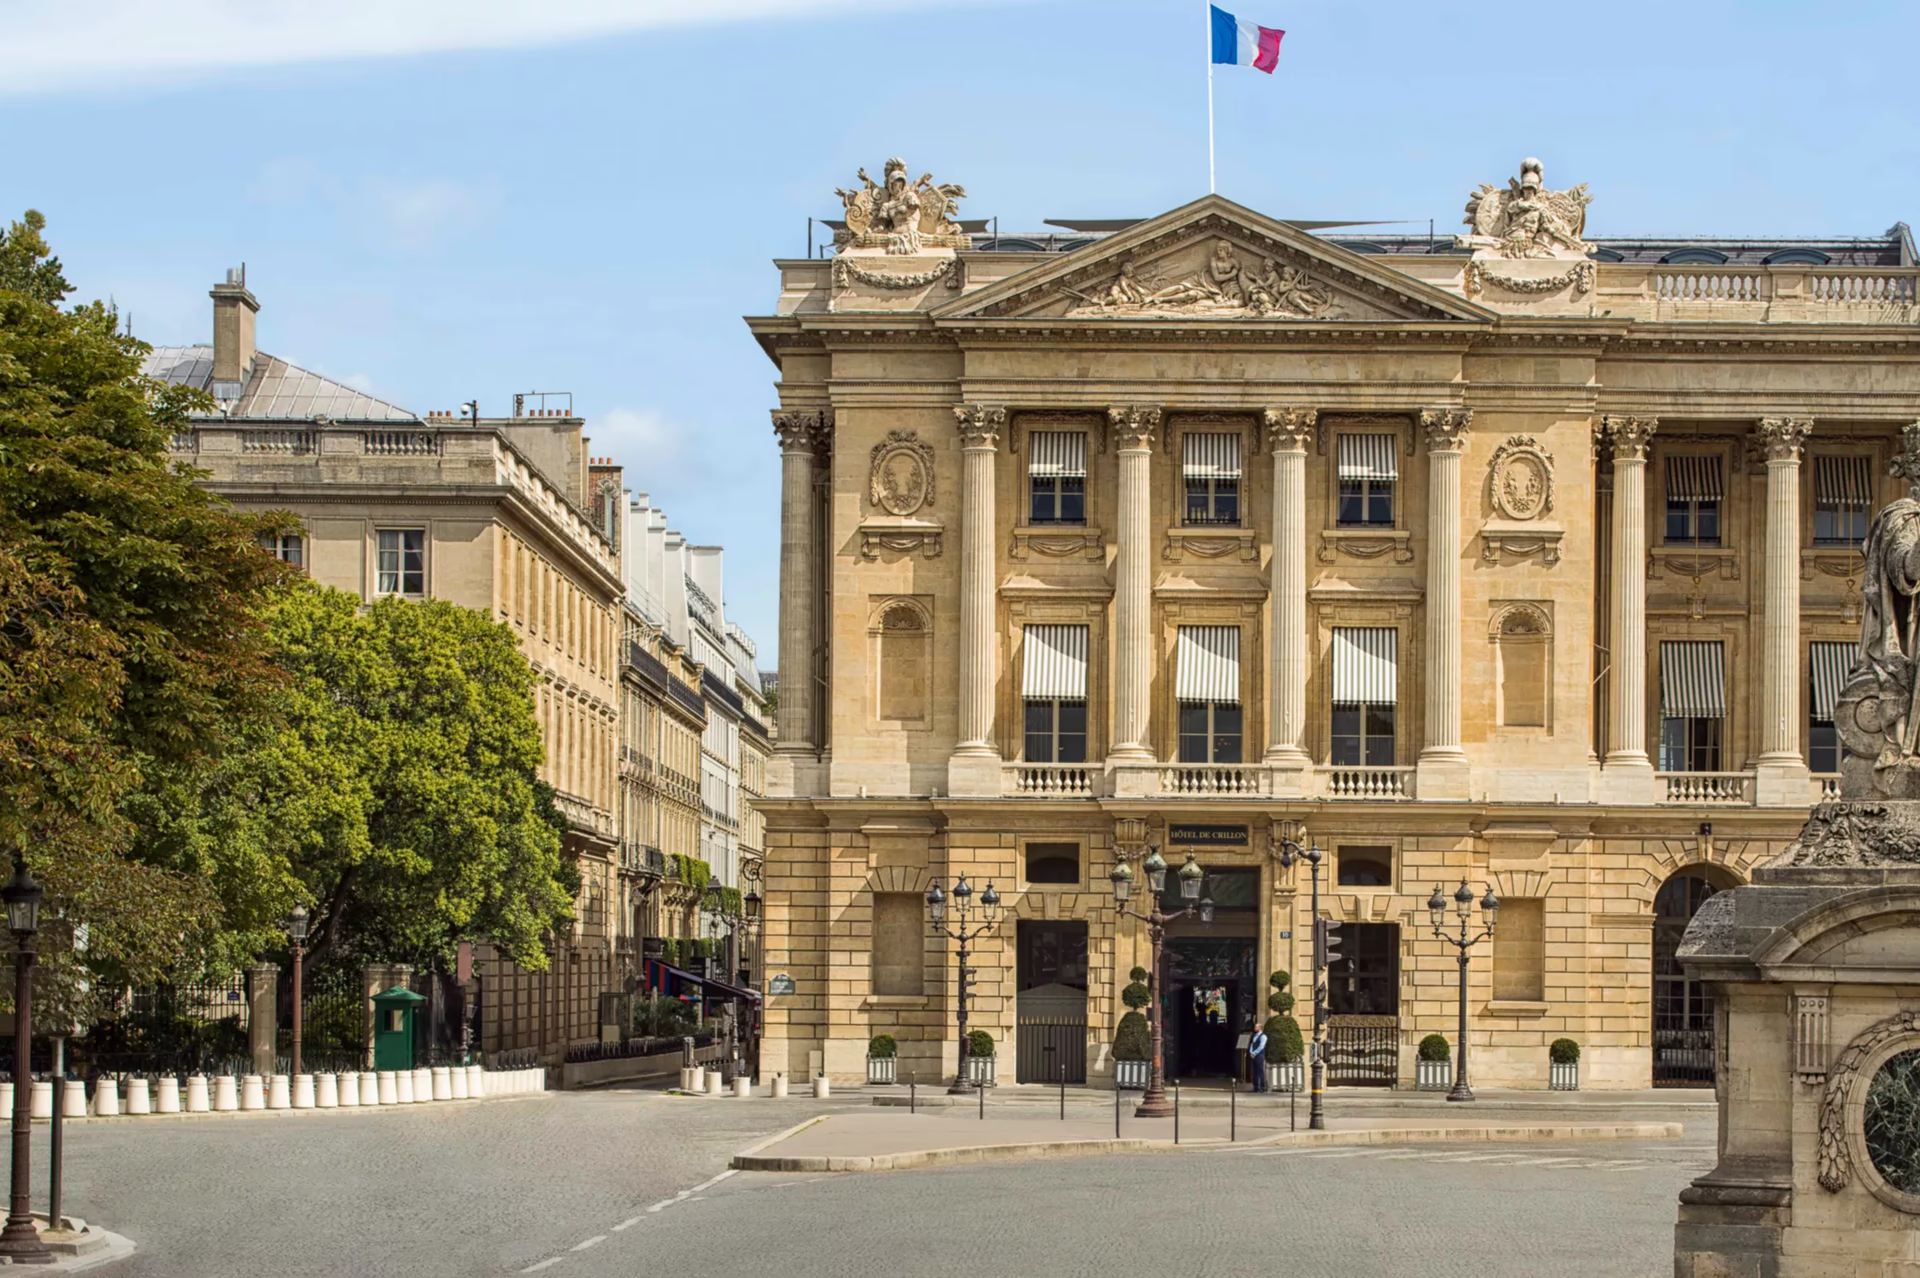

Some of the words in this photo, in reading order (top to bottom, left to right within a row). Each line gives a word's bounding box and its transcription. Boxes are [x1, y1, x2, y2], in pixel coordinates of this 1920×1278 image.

[1171, 829, 1198, 839] HÔTEL
[1199, 831, 1210, 839] DE
[1212, 831, 1246, 839] CRILLON
